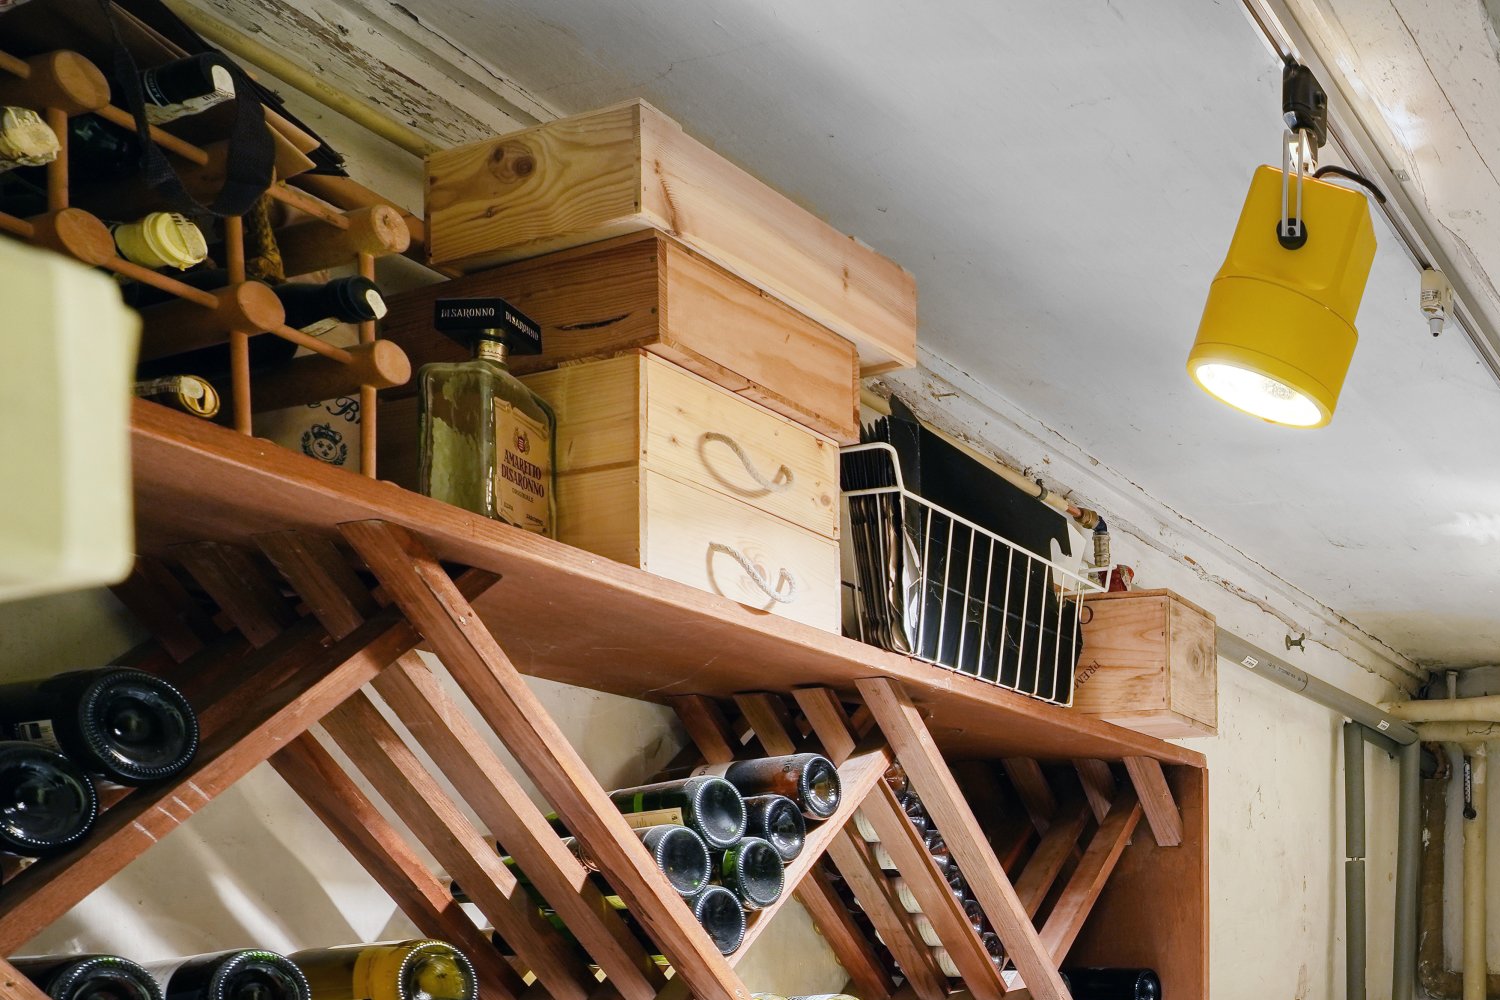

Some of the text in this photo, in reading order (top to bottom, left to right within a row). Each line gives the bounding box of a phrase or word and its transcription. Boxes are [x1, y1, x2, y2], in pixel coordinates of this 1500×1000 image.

[441, 307, 495, 318] DISARONNO
[505, 311, 539, 341] DISARONNO
[503, 449, 542, 480] AMARETTO
[501, 463, 545, 498] DISARONNO
[1074, 660, 1101, 690] PREM
